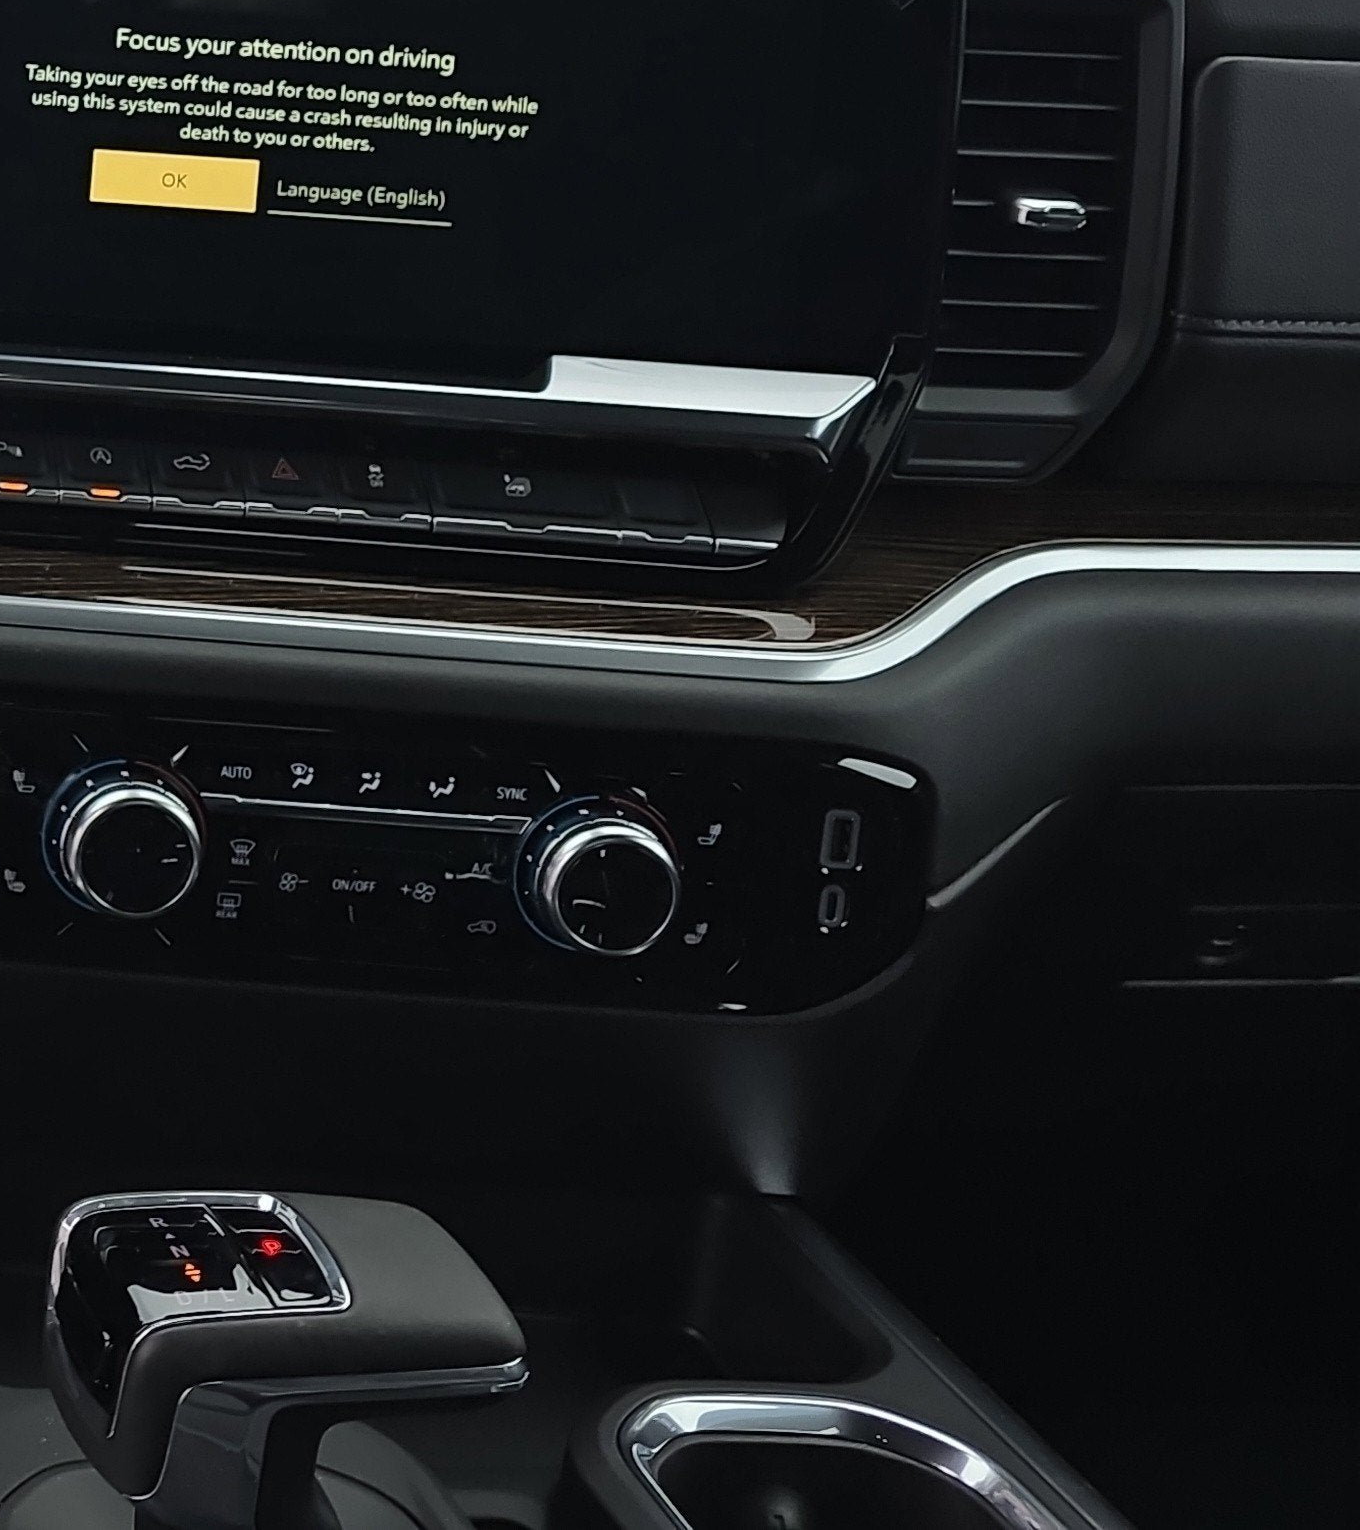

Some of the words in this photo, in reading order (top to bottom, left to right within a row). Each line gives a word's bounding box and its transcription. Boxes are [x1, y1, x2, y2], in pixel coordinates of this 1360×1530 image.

[116, 27, 182, 53] Focus
[184, 36, 236, 59] your
[238, 38, 341, 64] attention
[345, 47, 375, 66] on
[379, 43, 456, 77] driving
[25, 63, 82, 89] Taking
[84, 72, 125, 89] your
[127, 75, 168, 93] eyes
[170, 74, 200, 91] off
[200, 75, 230, 94] the
[233, 80, 274, 97] road
[276, 80, 303, 99] for
[306, 84, 337, 101] too
[340, 84, 380, 109] long
[382, 92, 404, 105] or
[406, 91, 437, 108] too
[439, 92, 489, 112] often
[492, 95, 539, 115] while
[31, 91, 80, 113] using
[83, 92, 116, 110] this
[118, 97, 181, 116] system
[184, 100, 233, 118] could
[235, 105, 286, 123] cause
[288, 110, 301, 123] a
[303, 109, 352, 126] crash
[354, 112, 432, 137] resulting
[435, 116, 452, 134] in
[455, 117, 506, 142] injury
[507, 124, 530, 139] or
[179, 123, 230, 143] death
[233, 127, 252, 144] to
[255, 132, 287, 150] you
[290, 133, 311, 148] or
[312, 132, 376, 153] others.
[161, 173, 188, 189] OK
[276, 180, 363, 205] Language
[366, 185, 446, 212] (English)
[220, 766, 252, 780] AUTO
[496, 787, 527, 801] SYNC
[332, 879, 376, 893] ON/OFF
[149, 1217, 169, 1228] R
[169, 1244, 191, 1258] N
